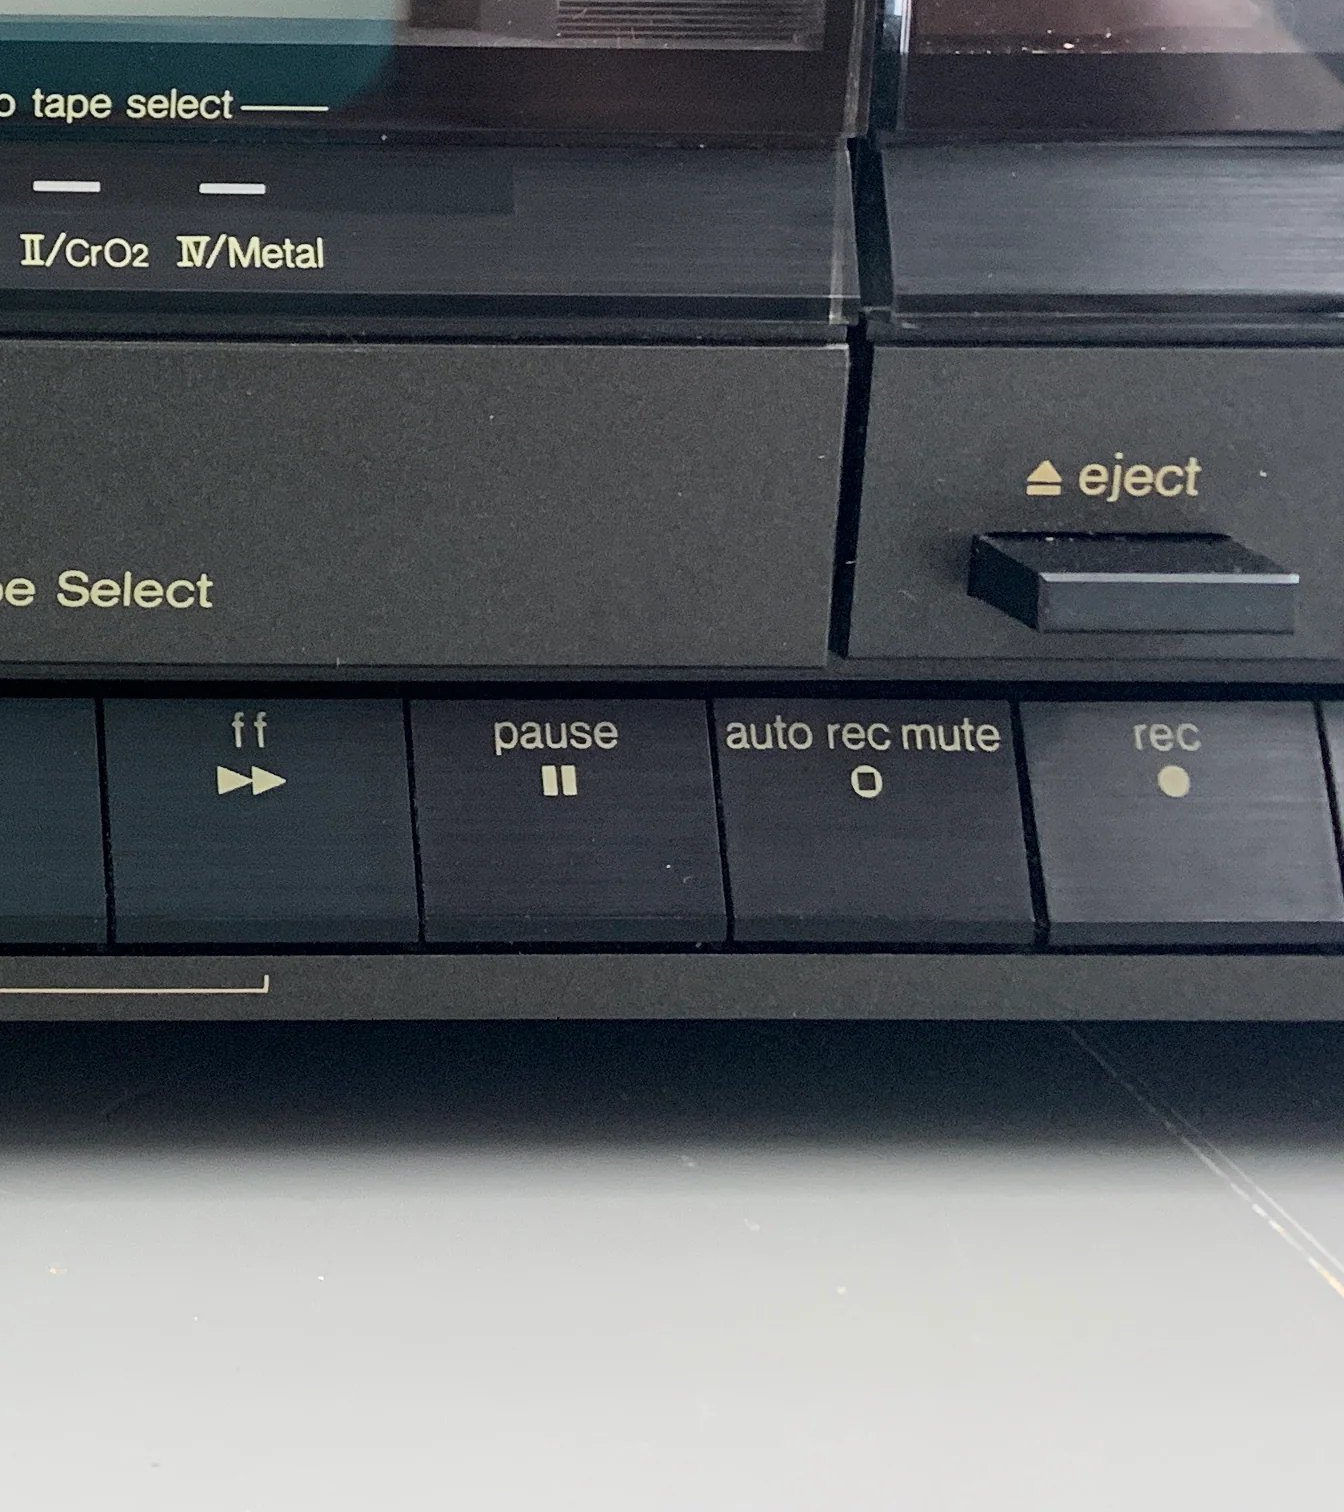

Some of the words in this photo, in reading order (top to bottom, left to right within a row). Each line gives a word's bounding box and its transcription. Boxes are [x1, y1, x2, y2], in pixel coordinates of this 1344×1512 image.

[32, 88, 112, 123] tape
[126, 88, 233, 119] select
[176, 234, 324, 269] IV/Metal
[1079, 452, 1201, 502] eject
[57, 570, 213, 608] Select
[495, 722, 618, 756] pause
[726, 715, 813, 750] auto
[828, 723, 891, 750] rec
[902, 718, 1000, 752] mute
[1134, 723, 1201, 751] rec
